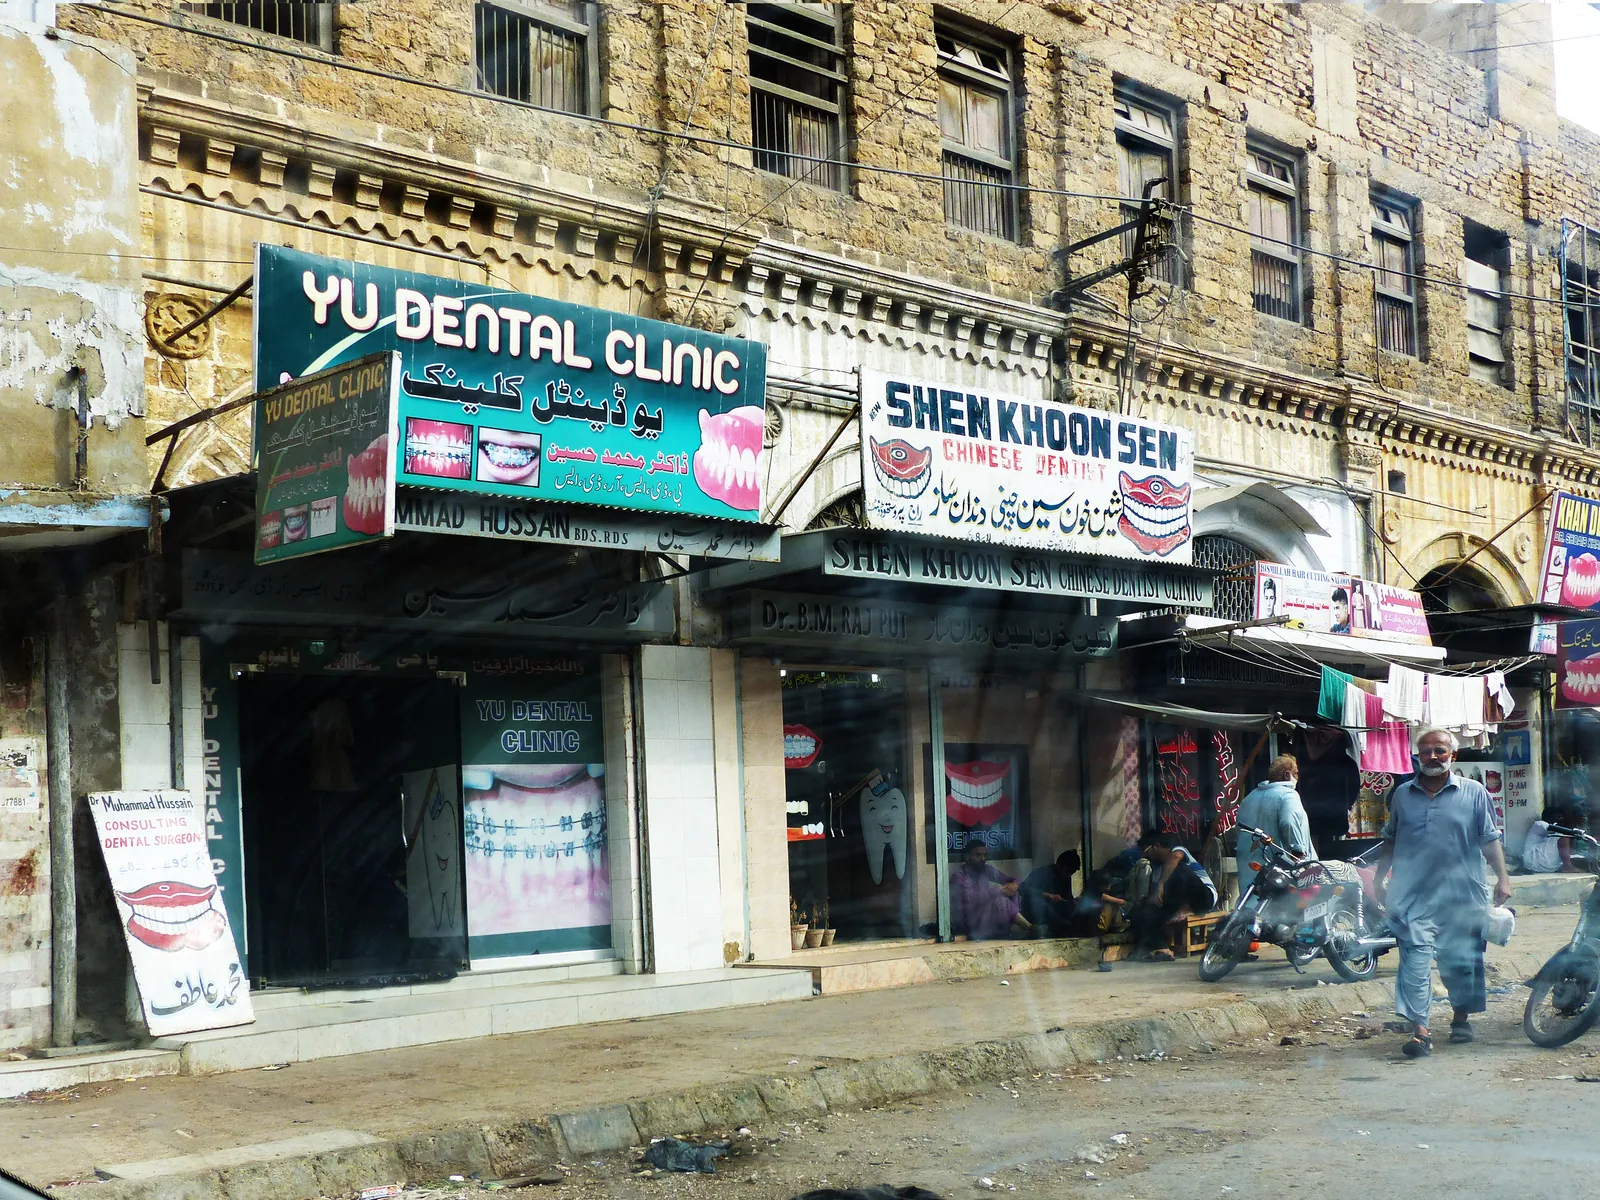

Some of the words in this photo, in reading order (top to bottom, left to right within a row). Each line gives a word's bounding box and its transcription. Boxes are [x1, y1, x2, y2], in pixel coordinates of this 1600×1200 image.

[302, 270, 379, 330] YU
[395, 288, 592, 369] DENTAL
[604, 329, 741, 394] CLINIC
[265, 399, 281, 424] YU
[284, 382, 336, 418] DENTAL
[339, 364, 385, 399] CLINIC
[402, 362, 524, 414] کلینک
[886, 381, 992, 441] SHEN
[997, 399, 1111, 460] KHOON
[1117, 421, 1177, 471] SEN
[546, 443, 598, 464] حسین
[601, 449, 646, 470] محمد
[943, 438, 1023, 472] CHINESE
[480, 504, 570, 540] HUSSAN
[1557, 497, 1590, 534] KHAN
[1589, 505, 1600, 537] D
[832, 538, 911, 578] SHEN
[922, 547, 1002, 587] KHOON
[1011, 557, 1053, 590] SEN
[1058, 563, 1110, 594] CHINESE
[1113, 568, 1160, 599] DENTIST
[1164, 574, 1203, 602] CLINIC
[1260, 563, 1291, 578] BISMILLAH
[1291, 567, 1306, 580] HAIR
[1306, 571, 1331, 583] CUTTING
[1331, 575, 1351, 586] SALOON
[841, 606, 872, 637] RAJ
[879, 610, 908, 640] PUT
[476, 699, 505, 722] YU
[511, 700, 592, 722] DENTAL
[501, 729, 580, 753] CLINIC
[203, 739, 223, 840] DENTAL
[1507, 769, 1526, 779] TIME
[89, 796, 100, 806] Dr
[101, 795, 155, 812] Muhammad
[155, 794, 194, 810] Hussain
[105, 817, 187, 831] CONSULTING
[105, 836, 151, 849] DENTAL
[153, 832, 201, 847] SURGEON
